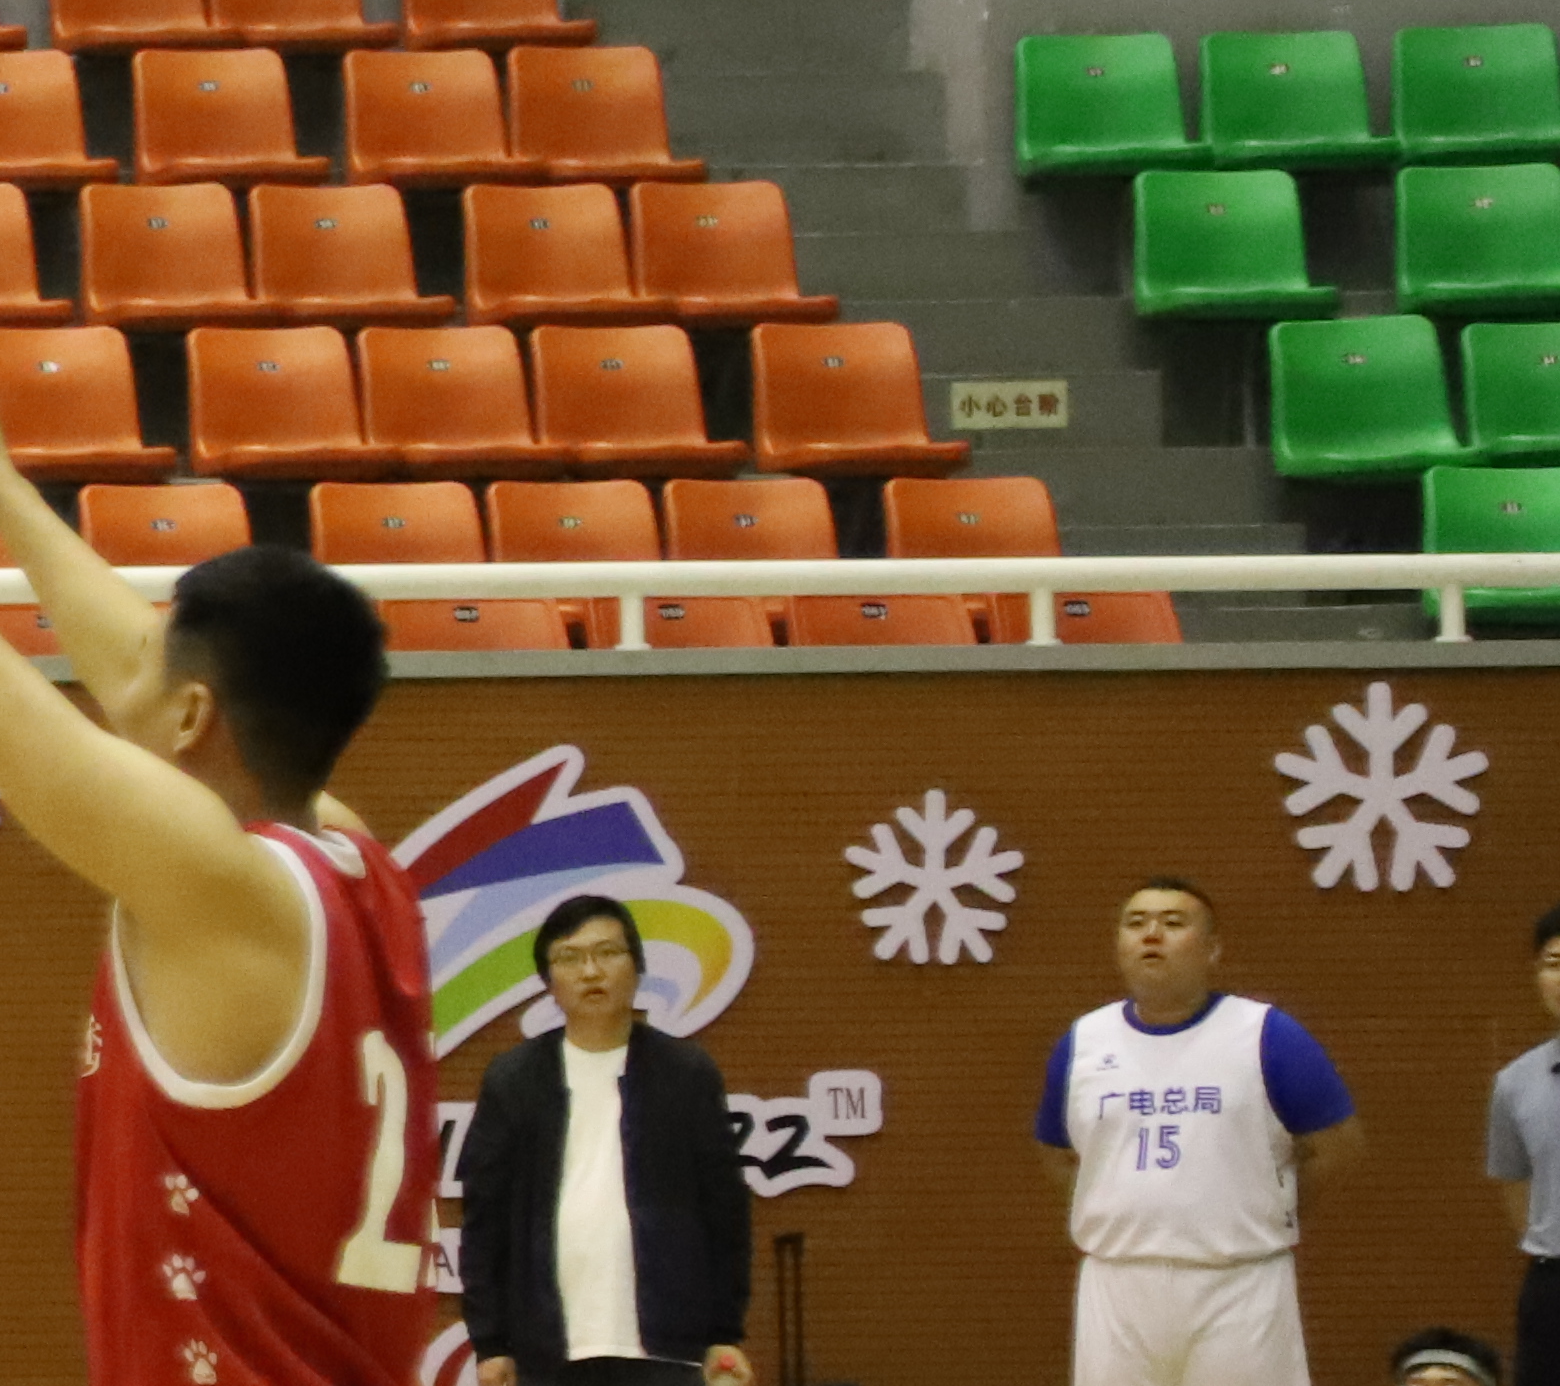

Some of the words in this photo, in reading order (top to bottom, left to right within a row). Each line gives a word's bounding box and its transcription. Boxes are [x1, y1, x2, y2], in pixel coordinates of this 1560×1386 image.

[827, 1086, 867, 1121] TM
[1099, 1086, 1222, 1121] 广电总局
[1136, 1125, 1181, 1172] 15
